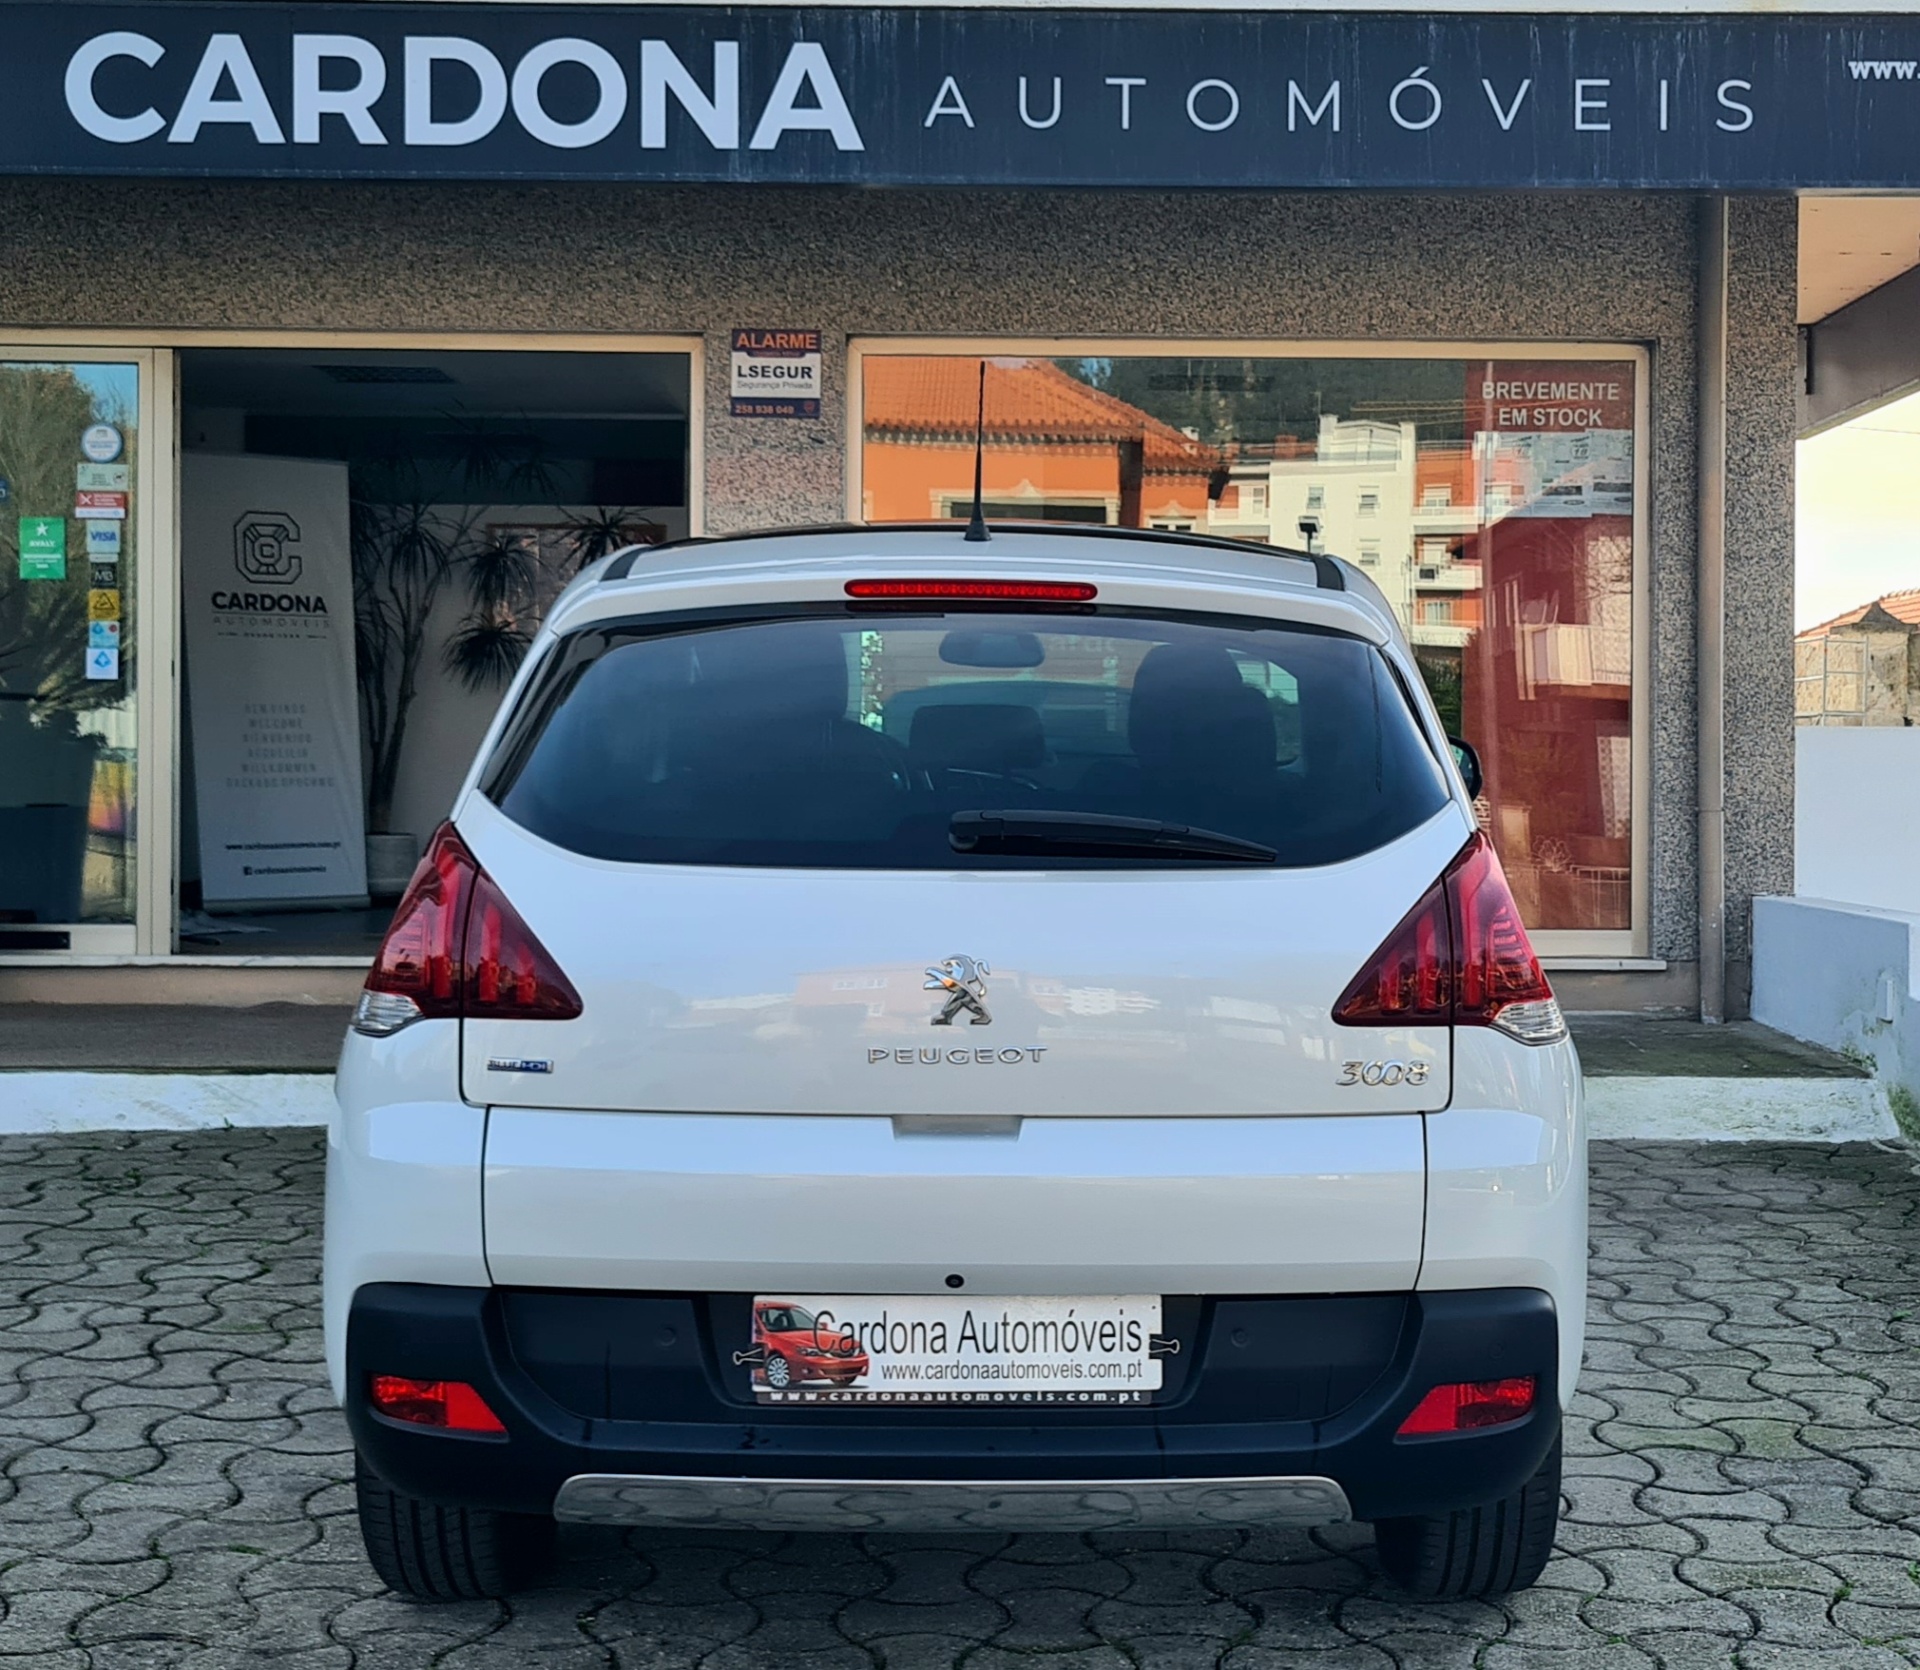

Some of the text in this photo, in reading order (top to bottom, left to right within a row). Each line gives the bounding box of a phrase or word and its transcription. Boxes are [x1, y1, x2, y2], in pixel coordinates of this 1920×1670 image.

[64, 31, 865, 152] CARDONA
[923, 67, 1755, 133] AUTOMÓVEIS
[737, 332, 818, 350] ALARME
[737, 365, 813, 380] LSEGUR
[1482, 381, 1620, 401] BREVEMENTE
[1499, 408, 1603, 426] EM STOCK
[90, 531, 117, 542] VISA
[211, 591, 328, 614] CARDONA
[867, 1046, 1048, 1065] PEUGEOT
[1335, 1060, 1430, 1087] 3008
[812, 1308, 1143, 1355] Cardona Automóveis
[881, 1359, 1144, 1383] www.cardonaautomoveis.com.pt
[769, 1390, 1143, 1405] www.cardonaautomoveis.com.pt
